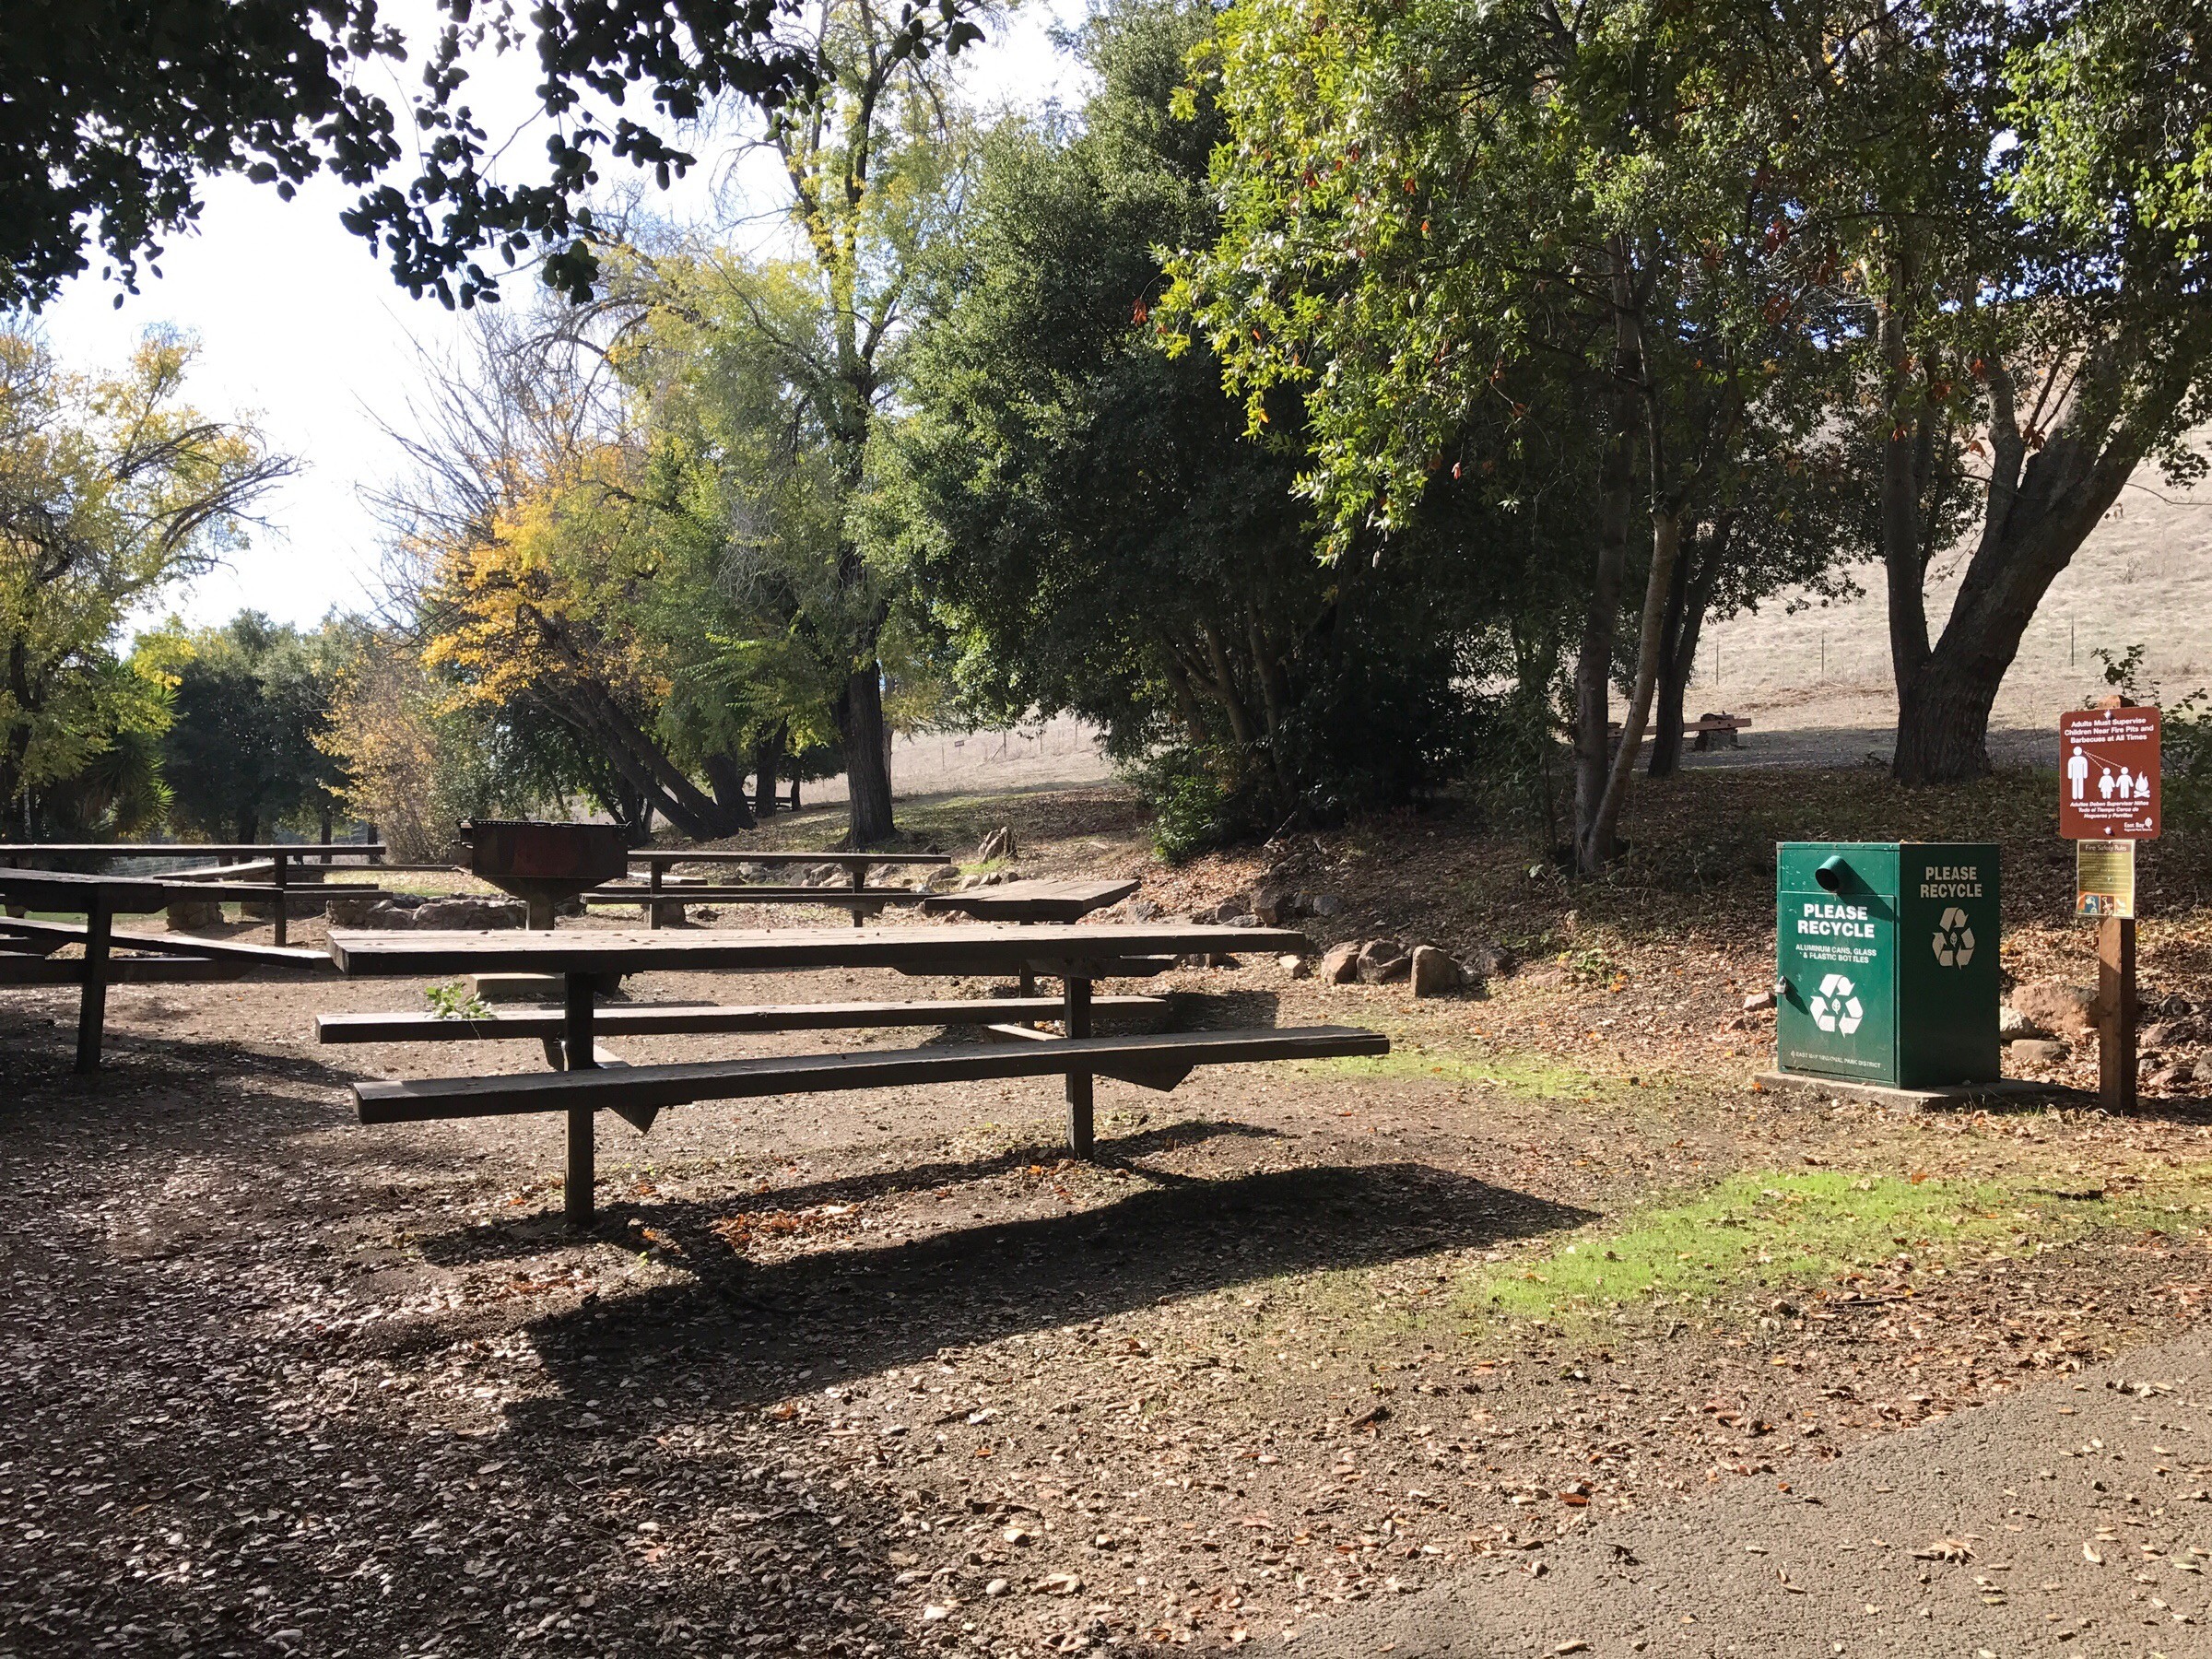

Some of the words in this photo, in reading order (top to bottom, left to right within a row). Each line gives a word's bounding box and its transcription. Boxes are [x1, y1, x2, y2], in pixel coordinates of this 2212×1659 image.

[1925, 866, 1977, 880] PLEASE
[1920, 884, 1982, 898] RECYCLE
[1804, 903, 1868, 921] PLEASE
[1798, 920, 1875, 938] RECYCLE
[1795, 944, 1830, 953] ALUMINUM
[1831, 946, 1852, 955] CANS,
[1838, 955, 1869, 964] BOTTLES
